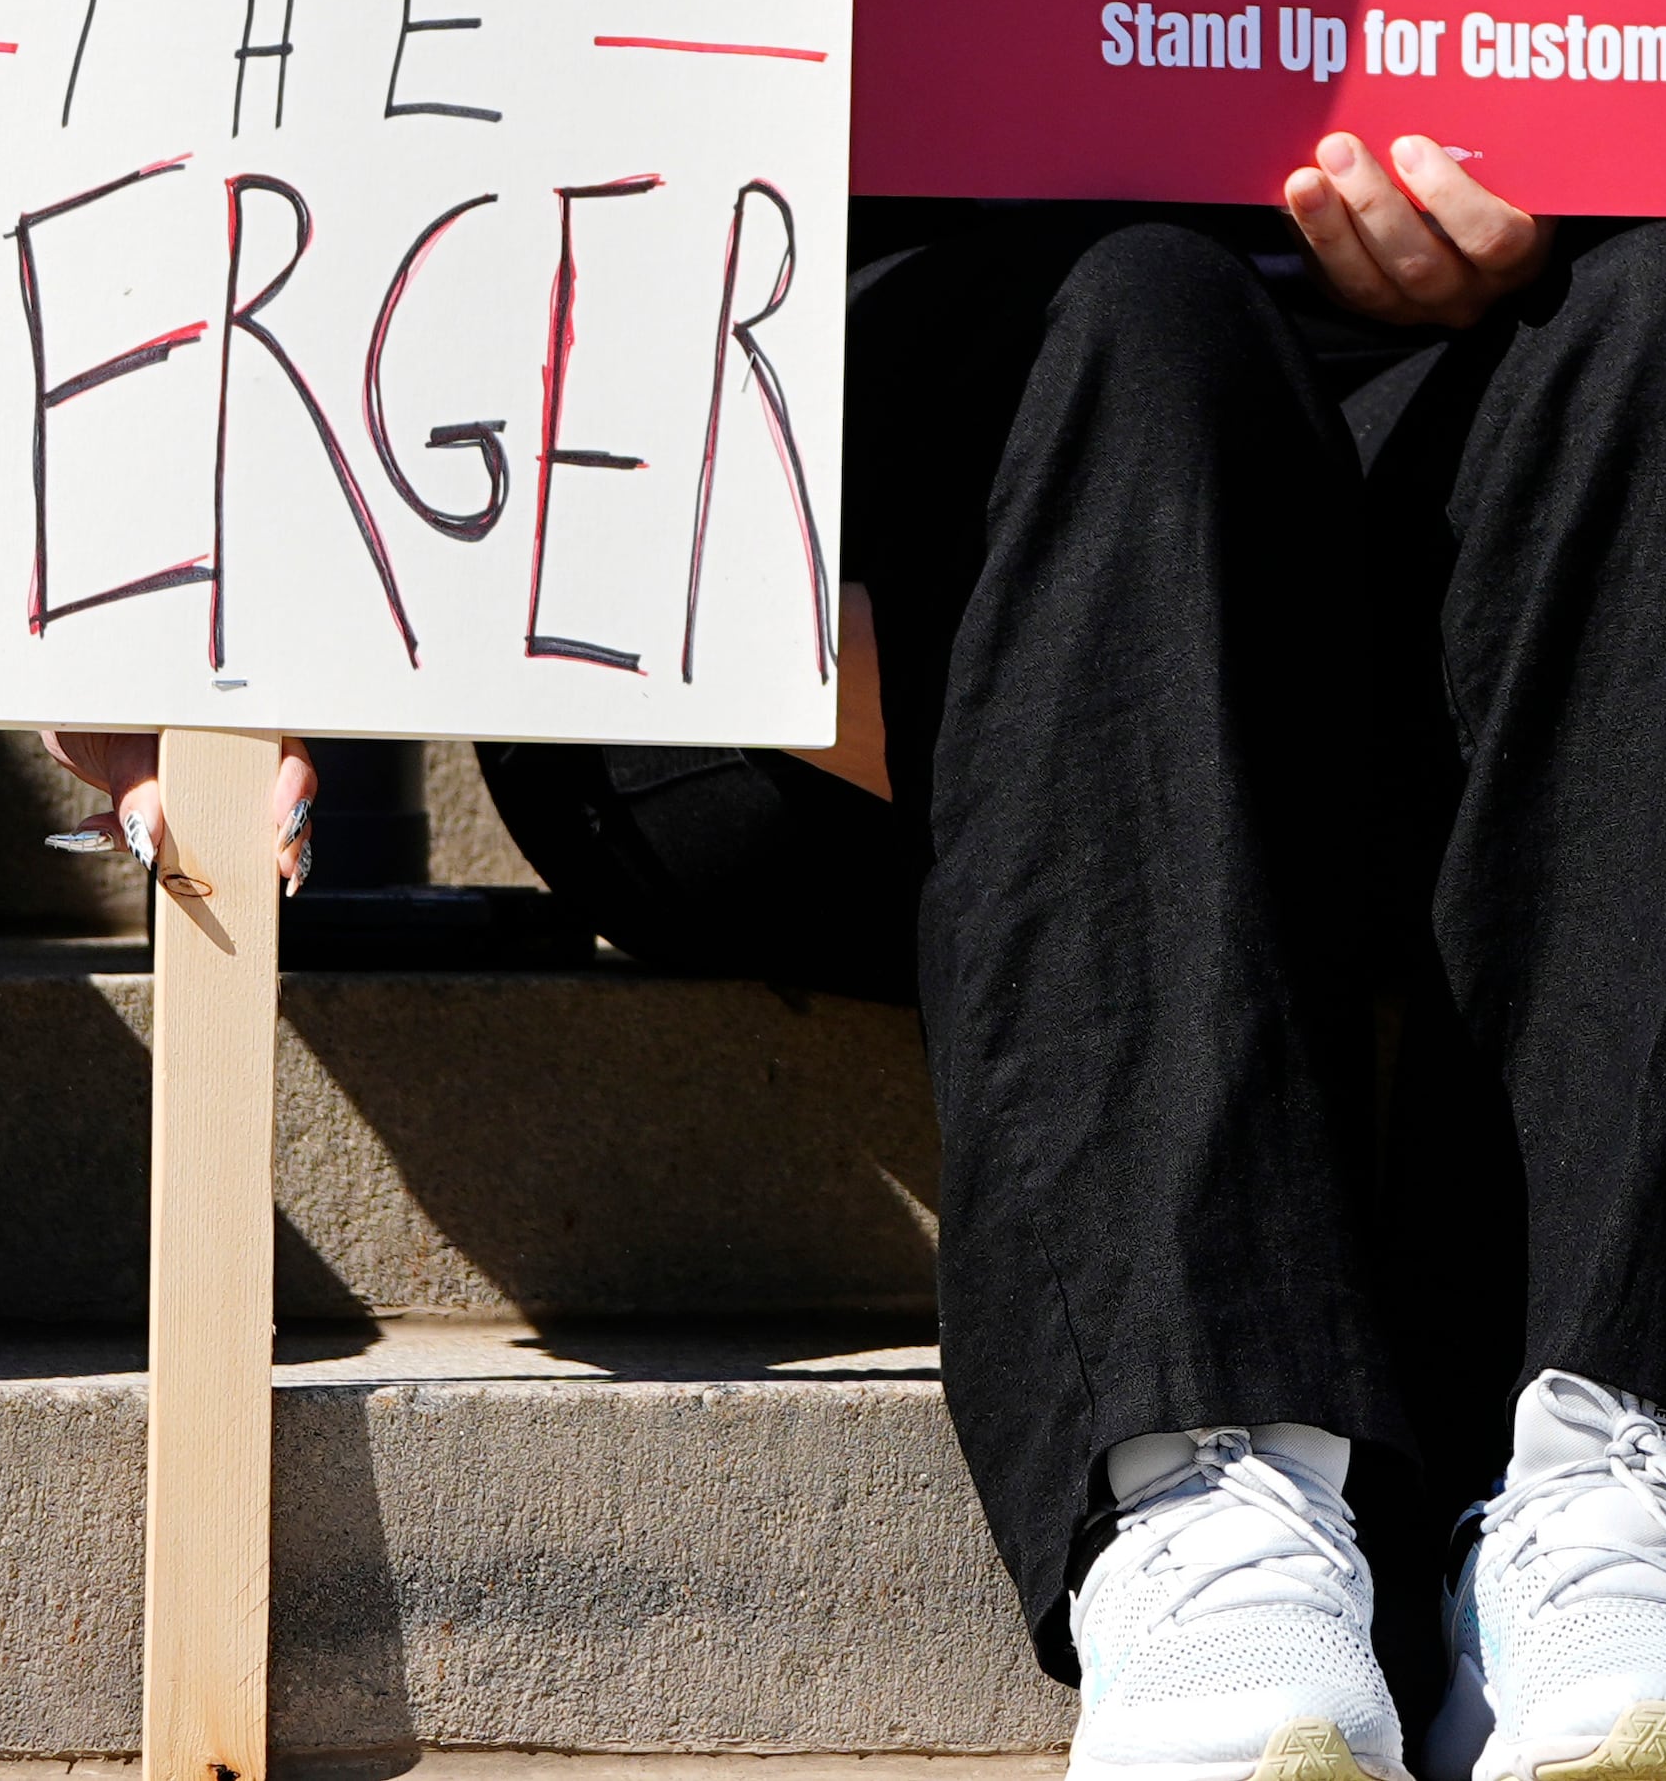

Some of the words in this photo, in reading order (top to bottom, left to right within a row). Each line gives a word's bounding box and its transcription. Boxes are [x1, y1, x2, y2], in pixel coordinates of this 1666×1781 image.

[1101, 1, 1261, 70] Stand
[1279, 6, 1347, 83] Up
[1362, 8, 1448, 78] for
